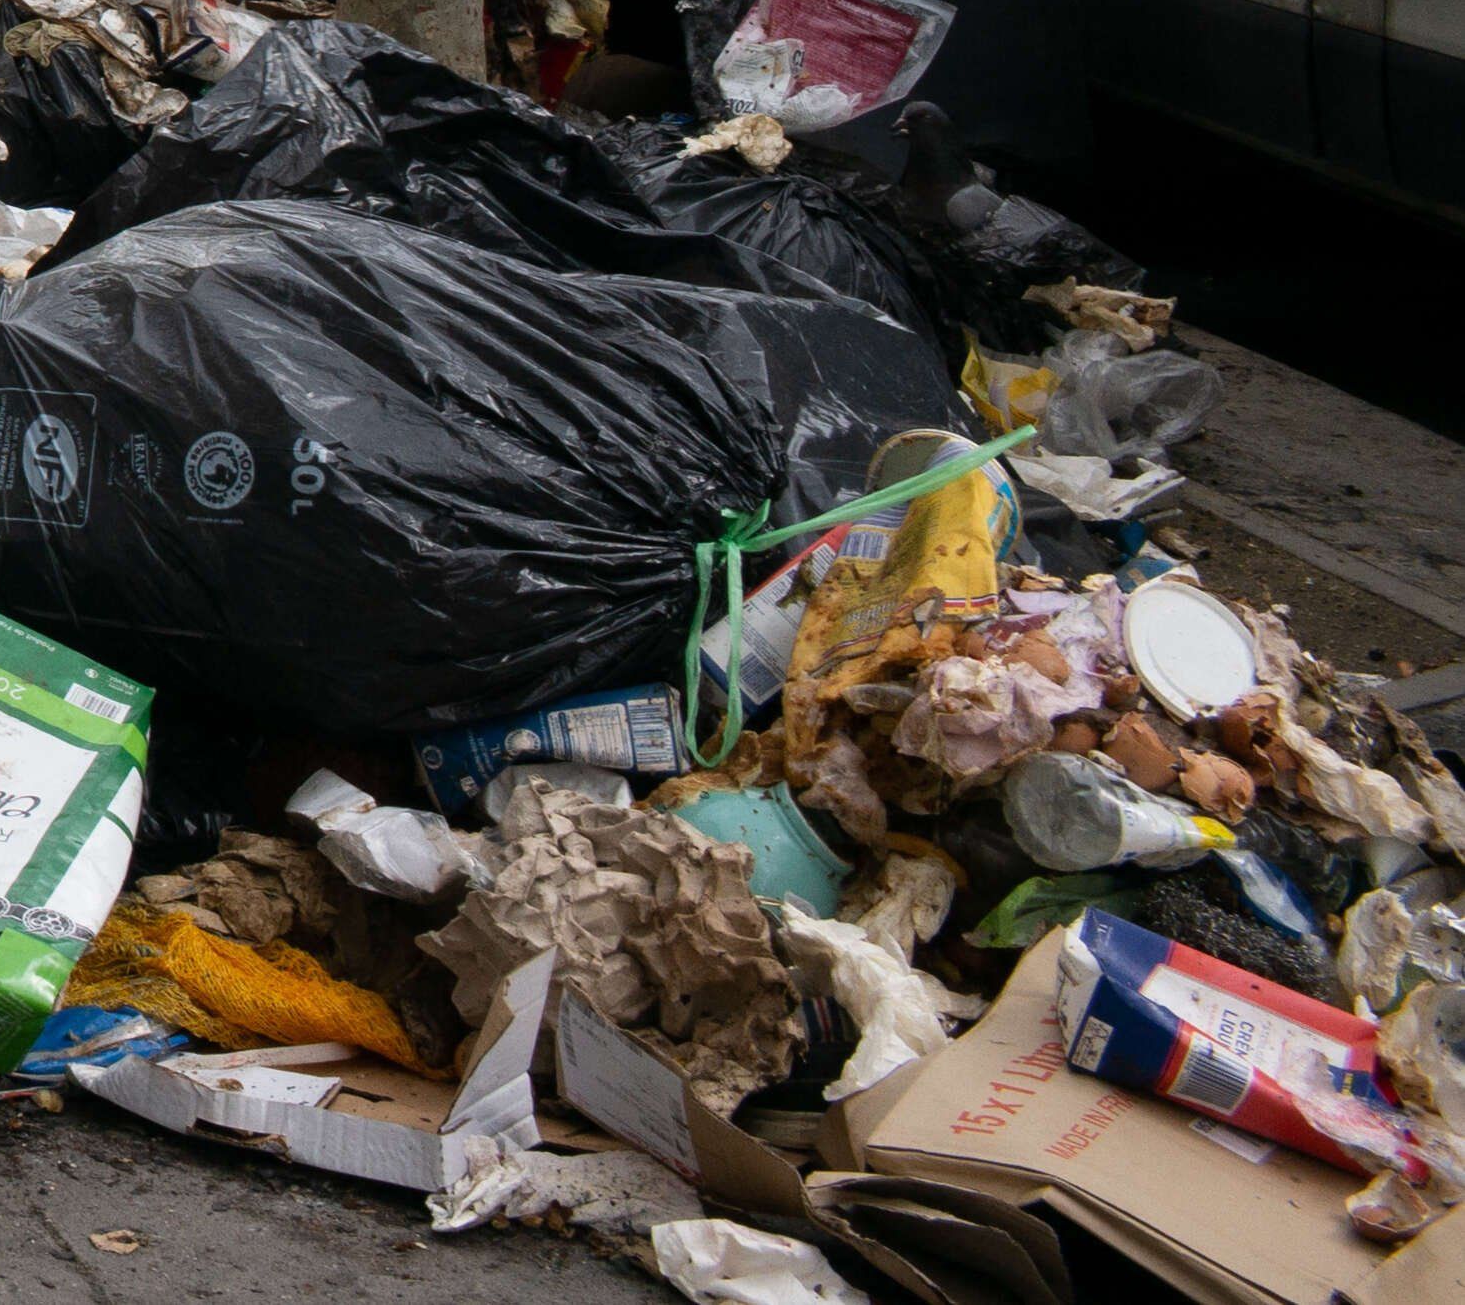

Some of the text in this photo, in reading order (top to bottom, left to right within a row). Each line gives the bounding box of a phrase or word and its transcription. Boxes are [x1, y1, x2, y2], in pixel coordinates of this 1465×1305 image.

[949, 1106, 996, 1137] 15
[1043, 1124, 1091, 1161] MADE
[1078, 1109, 1111, 1142] IN
